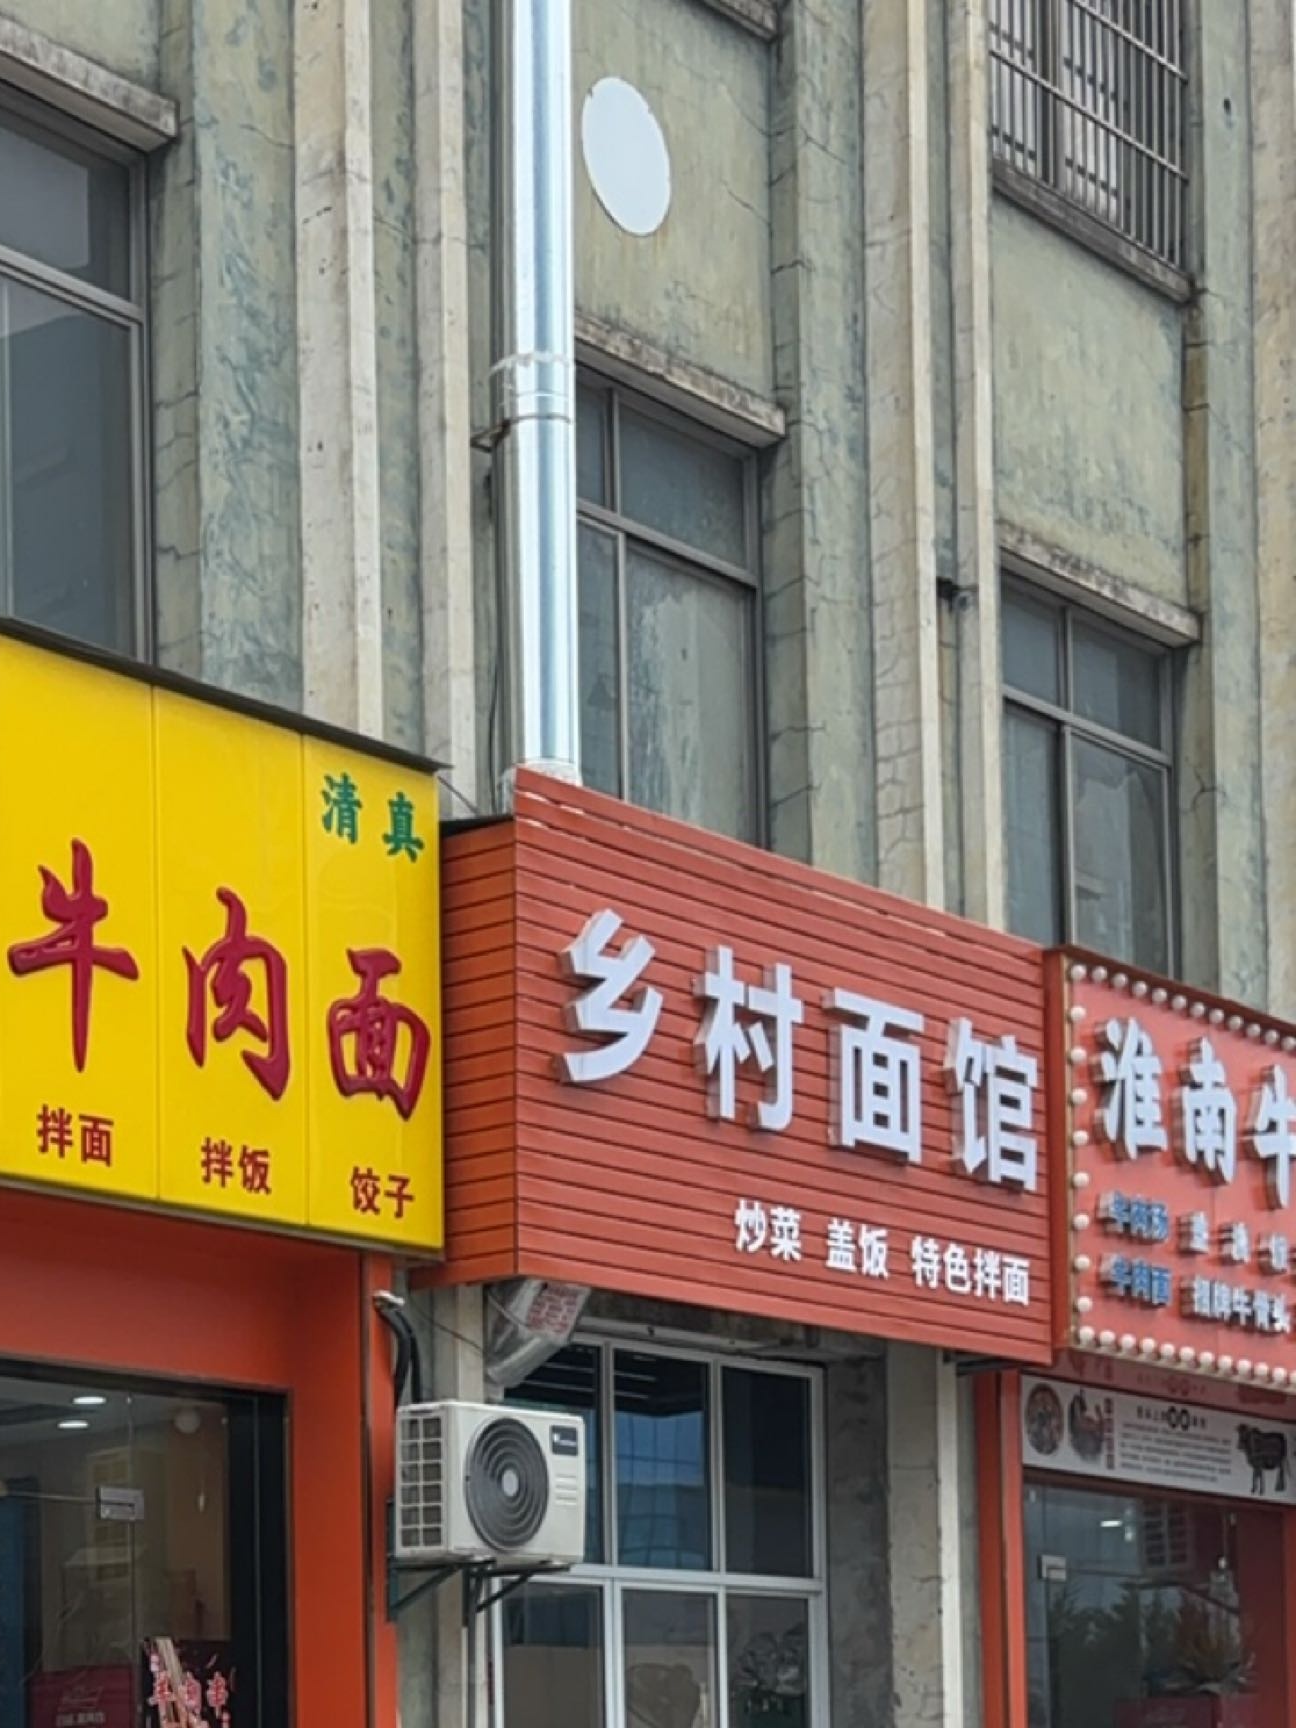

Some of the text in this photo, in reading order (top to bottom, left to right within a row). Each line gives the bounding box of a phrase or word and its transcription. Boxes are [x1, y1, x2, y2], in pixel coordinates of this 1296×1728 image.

[320, 772, 425, 864] 清真
[559, 907, 1038, 1194] 乡村面馆
[36, 1103, 114, 1167] 拌面
[200, 1136, 272, 1195] 拌饭
[350, 1166, 415, 1219] 饺子
[1097, 1015, 1296, 1208] 淮南牛
[734, 1198, 1031, 1306] 炒菜 盖饭 特色拌面
